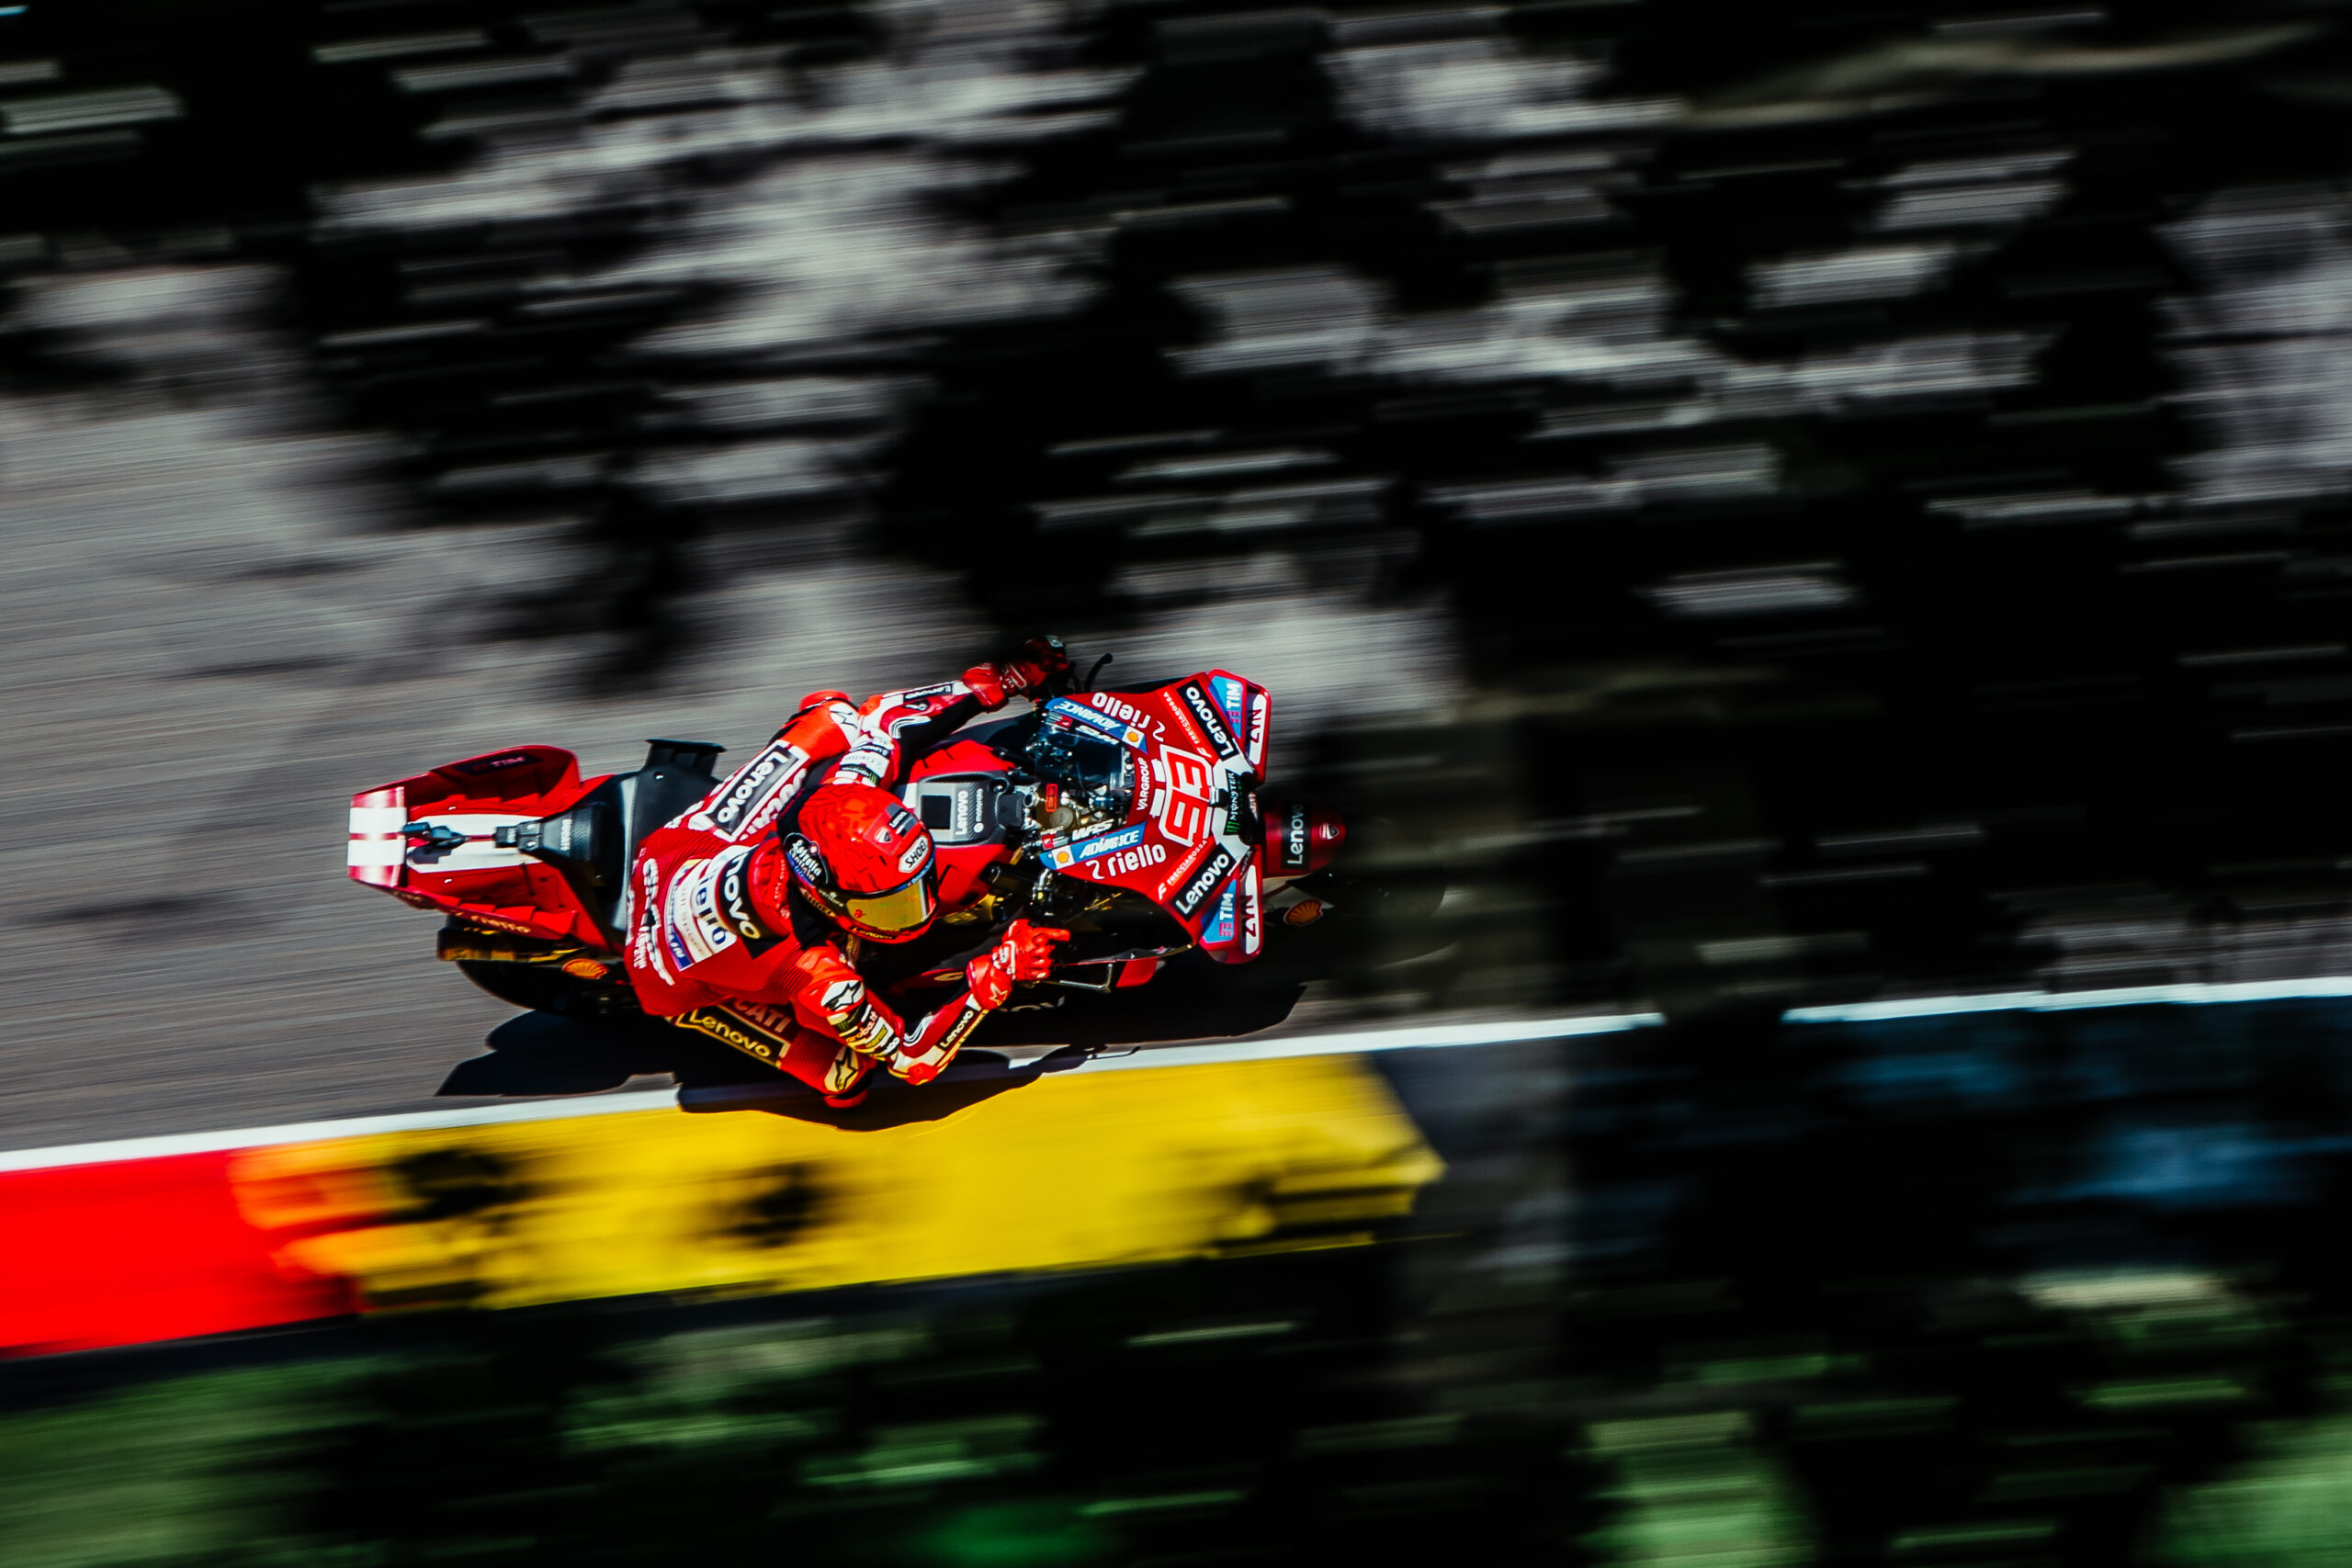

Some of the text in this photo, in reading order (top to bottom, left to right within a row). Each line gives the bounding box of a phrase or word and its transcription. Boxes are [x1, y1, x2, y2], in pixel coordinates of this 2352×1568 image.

[1057, 701, 1122, 731] ADVANCE
[1091, 692, 1150, 729] riello
[1163, 692, 1201, 745] FRECCIAROSSA
[1227, 682, 1240, 709] TIM
[1186, 686, 1234, 756] Lenovo
[717, 750, 789, 824] Lenovo
[976, 788, 984, 822] motorola
[1136, 757, 1150, 810] VARGROUP
[1164, 750, 1211, 842] 93
[955, 790, 969, 836] Lenovo
[1080, 829, 1140, 859] ADVANCE
[1107, 843, 1167, 877] riello
[1167, 840, 1208, 886] FRECCIAROSSA
[695, 867, 729, 946] iello
[724, 852, 761, 940] novo
[1176, 853, 1230, 915] Lenovo
[1219, 893, 1235, 921] TIM
[1240, 895, 1257, 938] ZYN
[689, 1009, 772, 1057] Lenovo
[734, 998, 792, 1033] CATI
[939, 1010, 974, 1048] Lenovo
